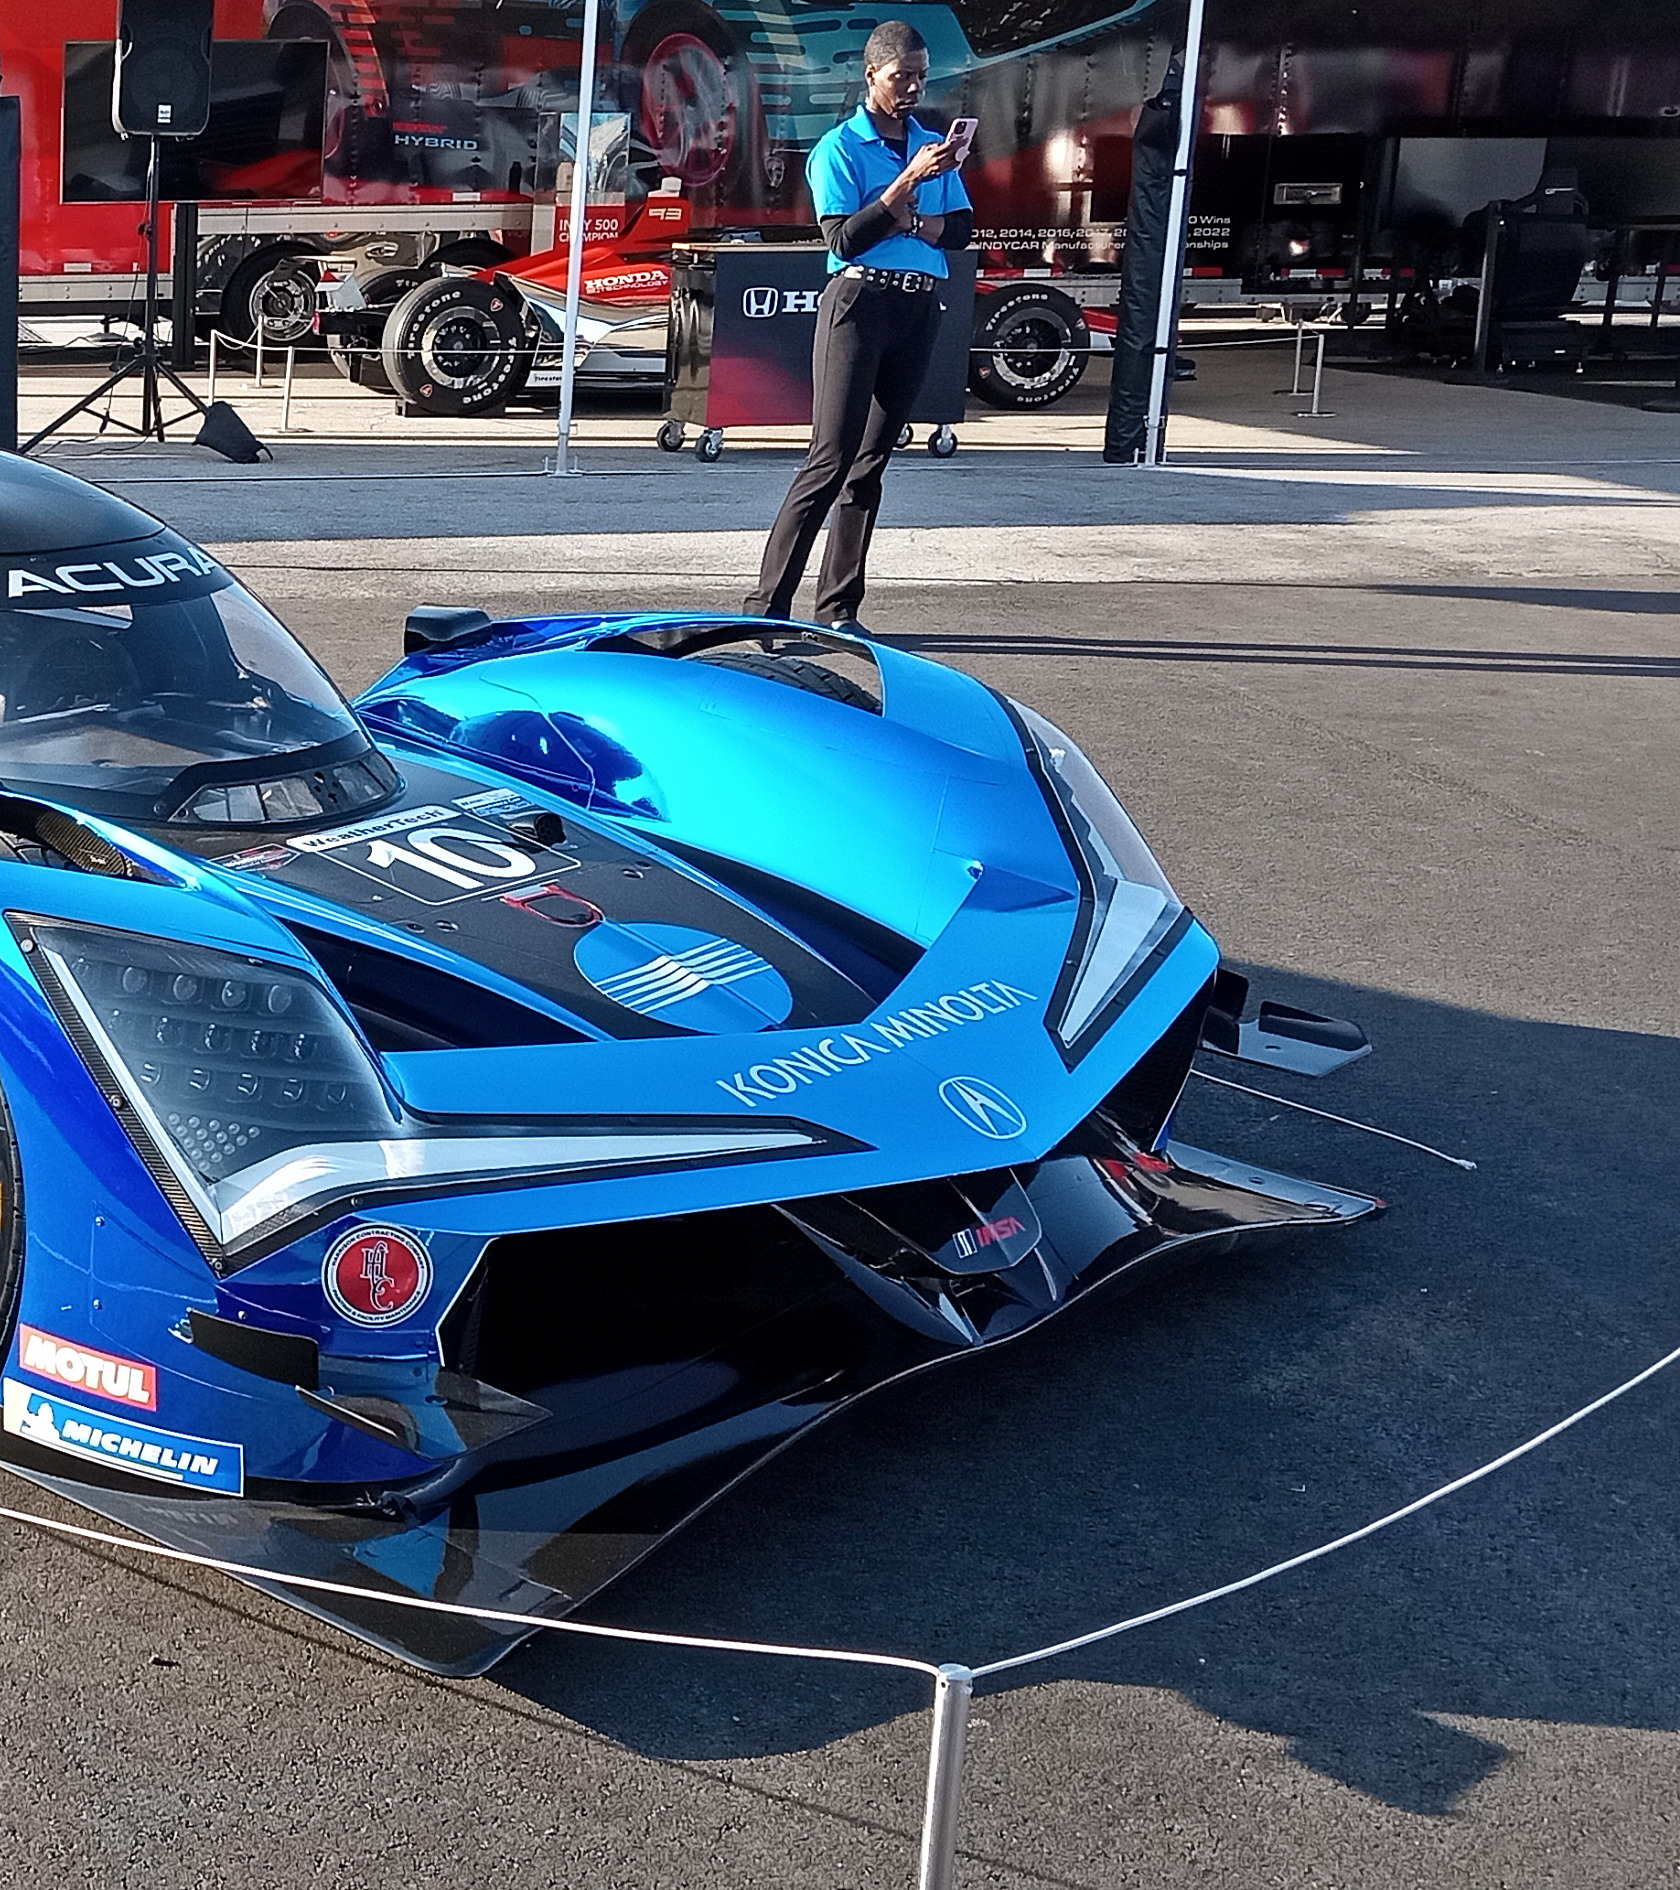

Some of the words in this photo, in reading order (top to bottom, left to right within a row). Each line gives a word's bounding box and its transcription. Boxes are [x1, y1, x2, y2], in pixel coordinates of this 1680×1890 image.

[394, 134, 478, 150] HYBRID
[649, 208, 682, 221] 93
[1199, 215, 1231, 224] Wins
[559, 219, 593, 232] INY
[595, 218, 619, 232] 500
[999, 228, 1036, 239] 2014,
[1037, 228, 1074, 239] 2016,
[1193, 227, 1231, 237] 2022
[559, 231, 619, 243] CHMPION
[584, 269, 669, 290] HONDA
[534, 374, 562, 382] Firesto
[8, 547, 218, 598] ACURA
[301, 808, 444, 849] WeatherTech
[366, 826, 536, 889] 10
[715, 1033, 890, 1107] KONICA
[870, 979, 1038, 1048] MINOLTA
[331, 1236, 356, 1267] HARRISON
[356, 1229, 405, 1243] CONTRACTING
[405, 1240, 426, 1270] COMPANY
[24, 1334, 150, 1404] MOTUL
[62, 1419, 219, 1476] MICHELIN
